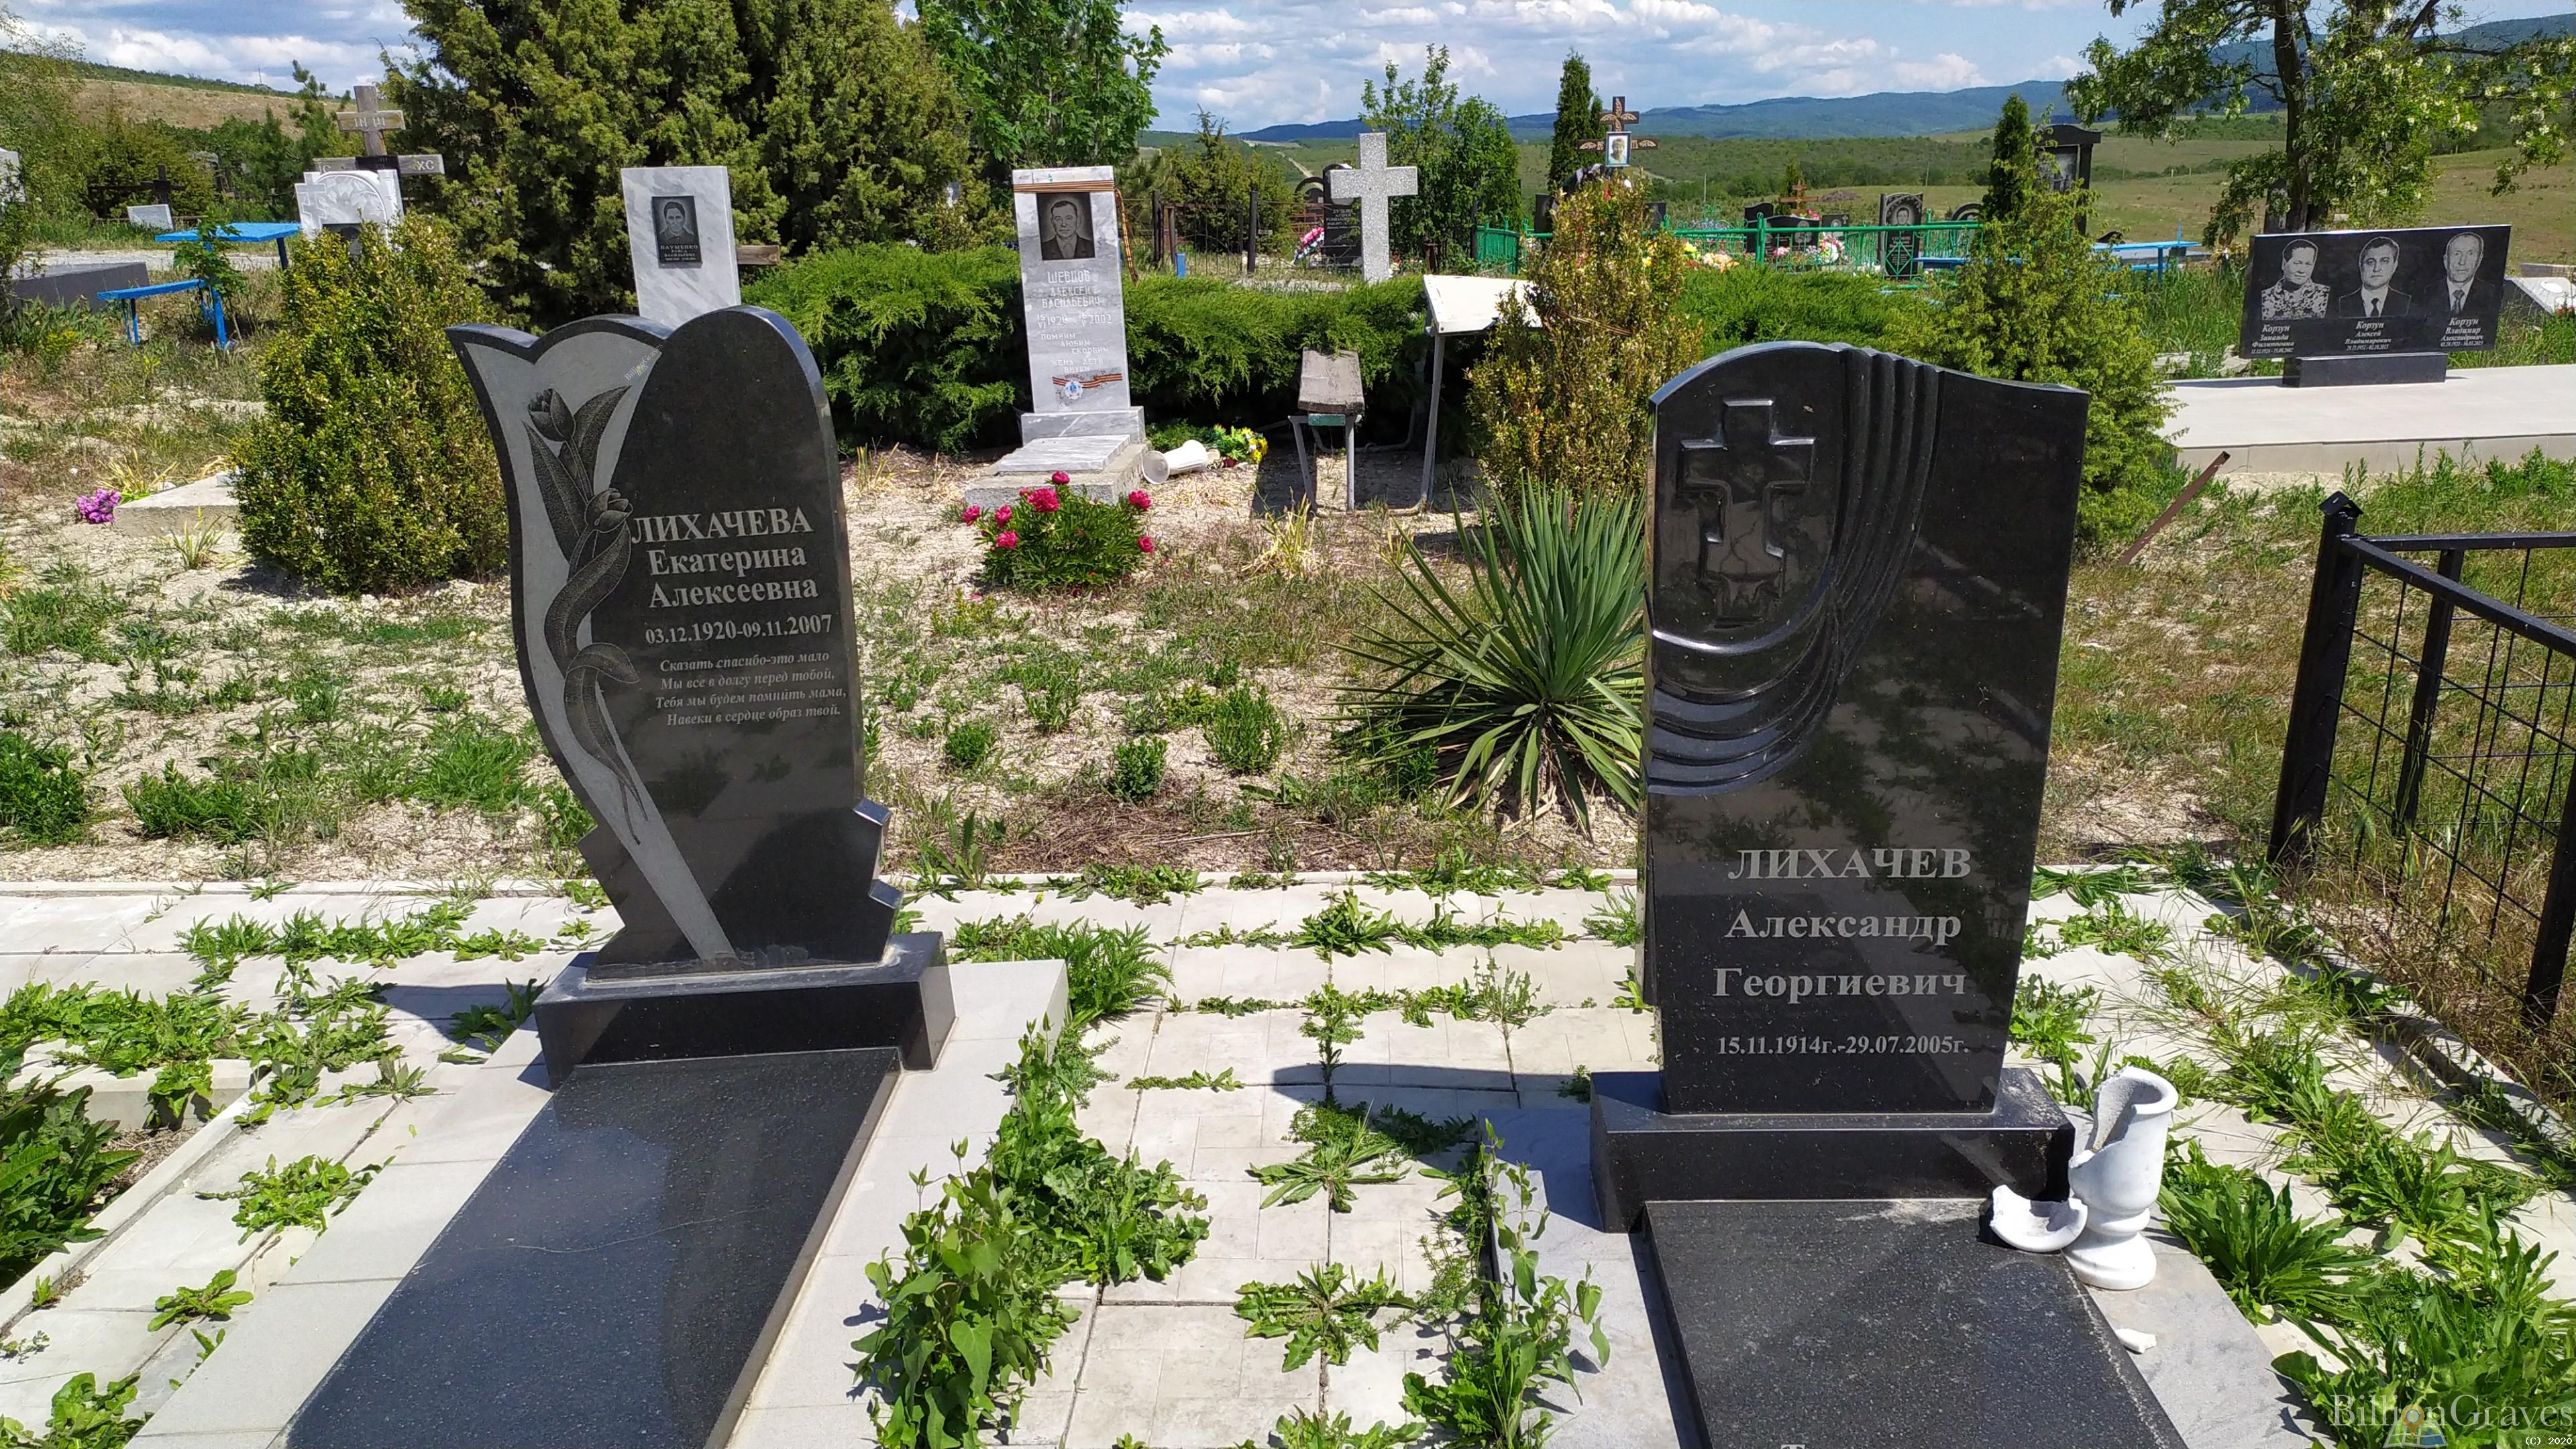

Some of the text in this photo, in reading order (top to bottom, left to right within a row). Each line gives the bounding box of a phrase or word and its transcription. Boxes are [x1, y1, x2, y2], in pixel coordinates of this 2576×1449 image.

[1046, 270, 1090, 283] ШЕВЦОВ
[1042, 296, 1100, 309] ВАСИЛЬЕВИЧ
[2261, 323, 2291, 334] Корзун
[2355, 321, 2385, 331] Корзун
[2445, 326, 2481, 335] Владимир
[2449, 317, 2479, 327] Корзун
[631, 506, 814, 543] ЛИХАЧЕВА
[646, 545, 808, 578] Екатерина
[649, 578, 819, 608] Алексеевна
[645, 614, 833, 645] 03.12.1920-09.11.2007
[660, 659, 714, 672] Сказать
[797, 651, 830, 663] мало
[661, 667, 835, 690] Мы все в долгу перед тобой,
[655, 687, 847, 708] Тебя мы будем помнить мама,
[666, 712, 712, 726] Навеки
[715, 712, 722, 722] в
[724, 708, 766, 724] сердце
[768, 706, 802, 722] образ
[1727, 848, 1972, 880] ЛИХАЧЕВ
[1723, 908, 1962, 947] Александр
[1712, 967, 1968, 1004] Георгиевич
